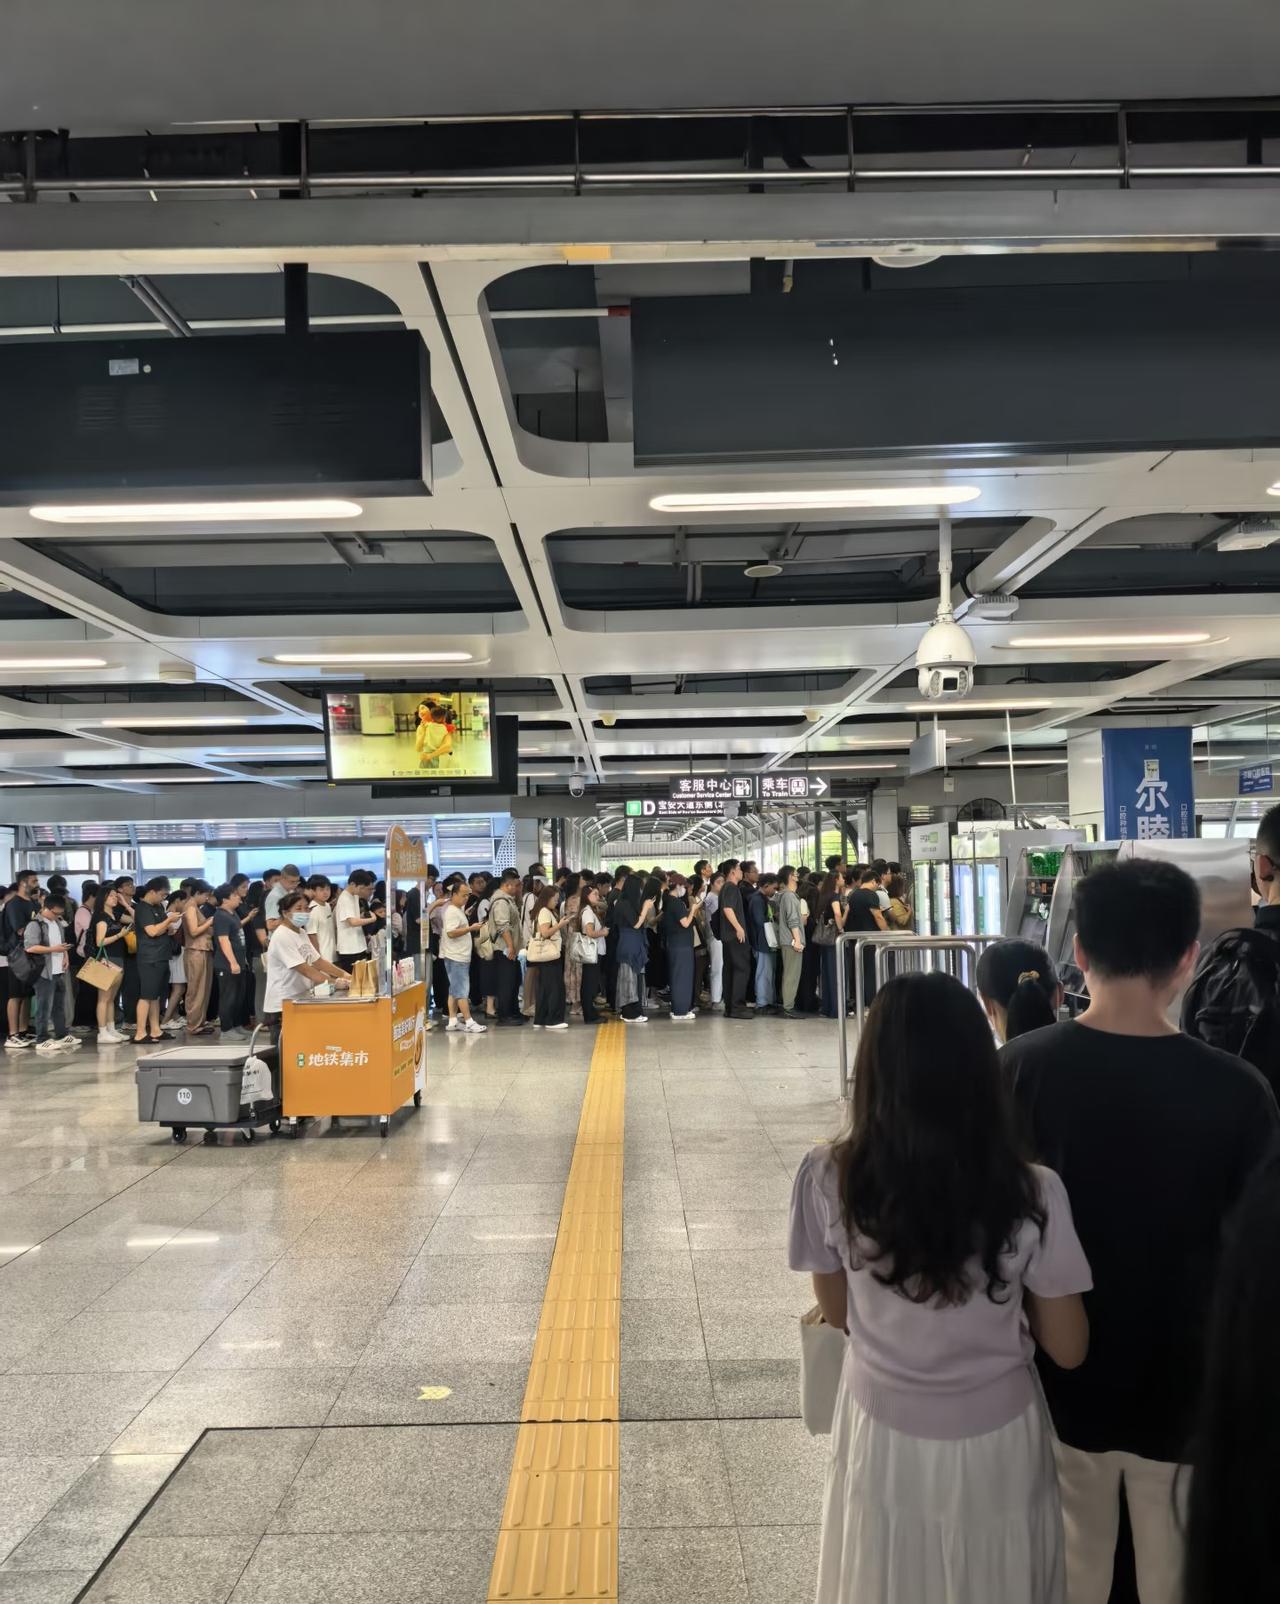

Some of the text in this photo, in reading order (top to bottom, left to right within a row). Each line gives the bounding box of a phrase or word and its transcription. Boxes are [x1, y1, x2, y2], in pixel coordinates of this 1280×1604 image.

[679, 779, 732, 792] 客服中心
[762, 777, 788, 790] 乘车
[643, 800, 656, 815] D
[308, 1050, 369, 1067] 地铁集市
